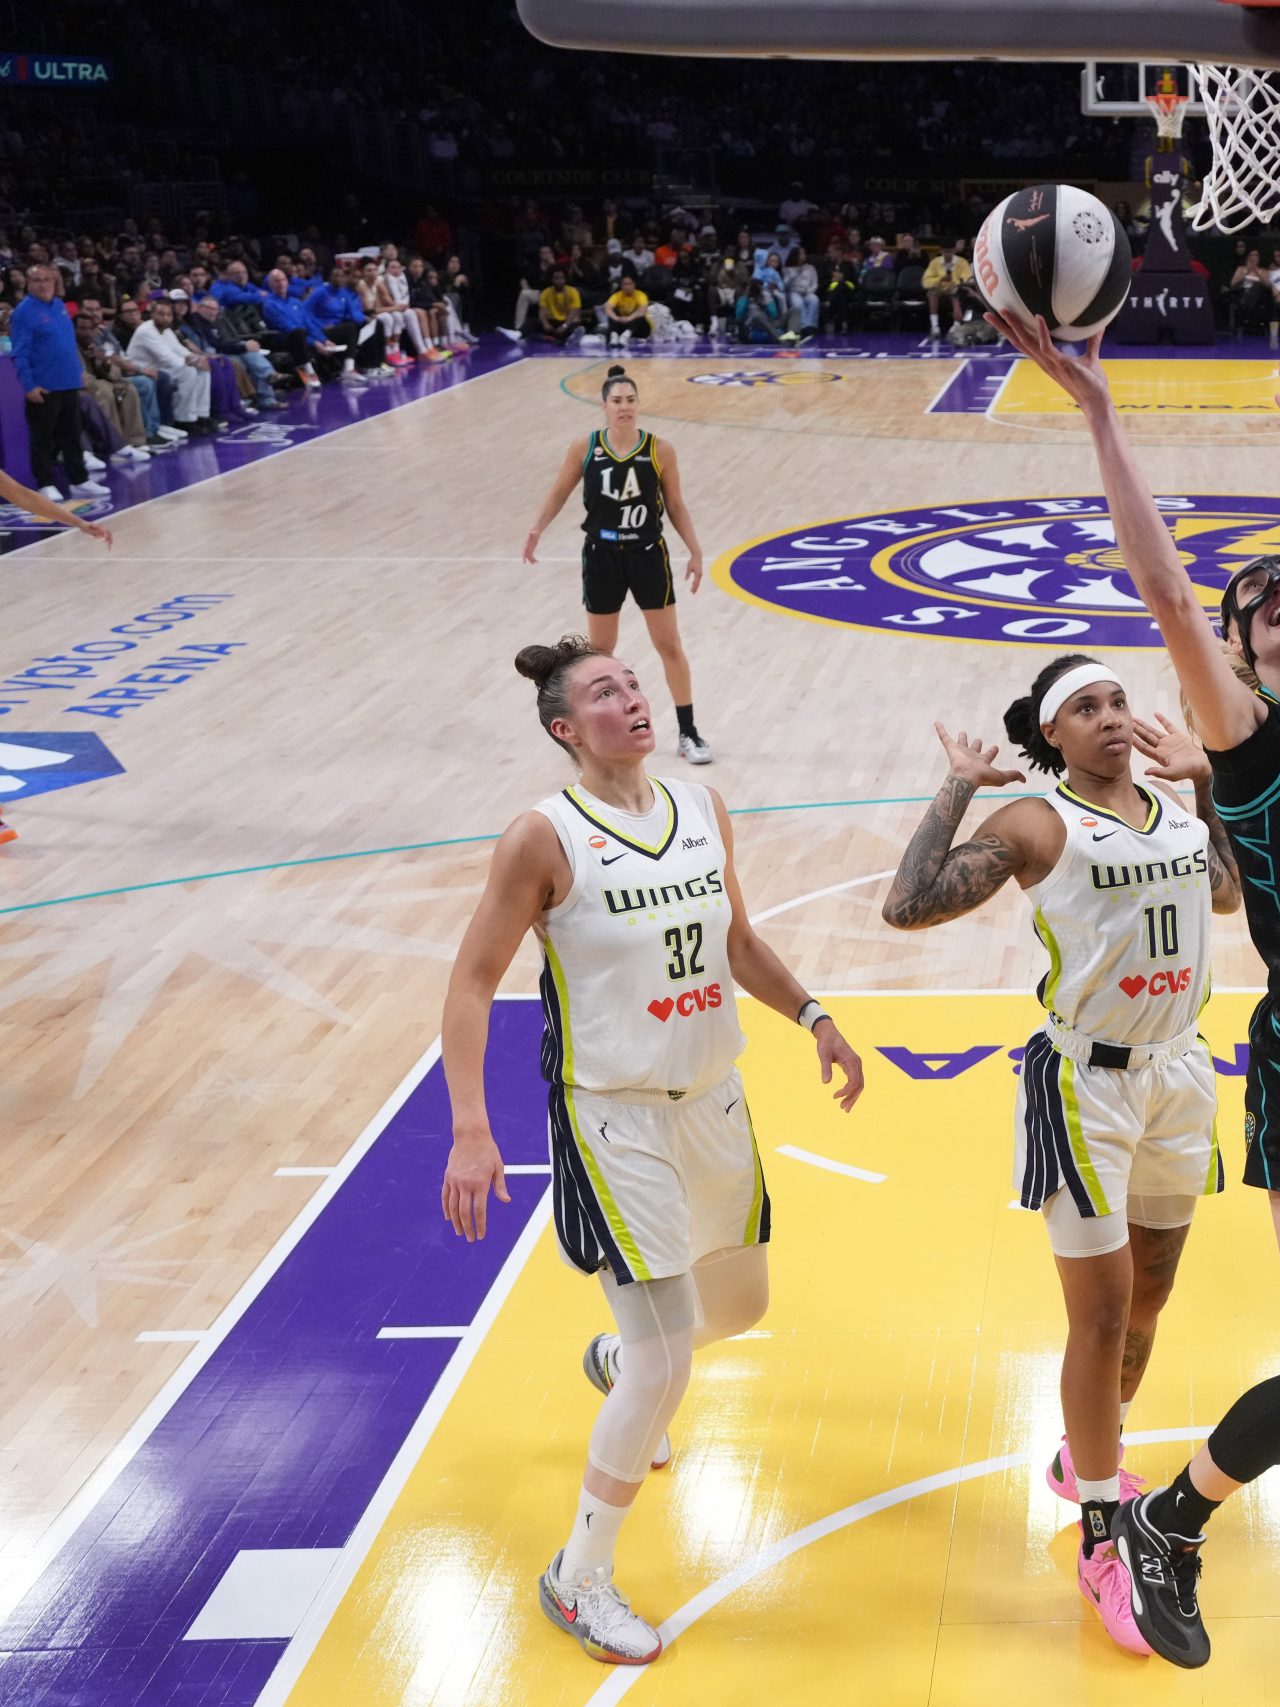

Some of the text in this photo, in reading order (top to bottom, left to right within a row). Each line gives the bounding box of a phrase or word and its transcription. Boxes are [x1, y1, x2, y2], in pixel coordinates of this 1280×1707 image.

[34, 61, 109, 80] ULTRA
[1153, 170, 1180, 187] ally
[601, 466, 642, 501] LA
[618, 504, 648, 529] 10
[61, 642, 248, 719] ARENA
[682, 836, 709, 851] Albert
[1090, 848, 1209, 890] WINGS
[602, 868, 724, 916] WINGS
[1143, 903, 1180, 960] 10
[663, 921, 706, 981] 32
[1148, 966, 1192, 996] CVS
[675, 982, 723, 1018] CVS
